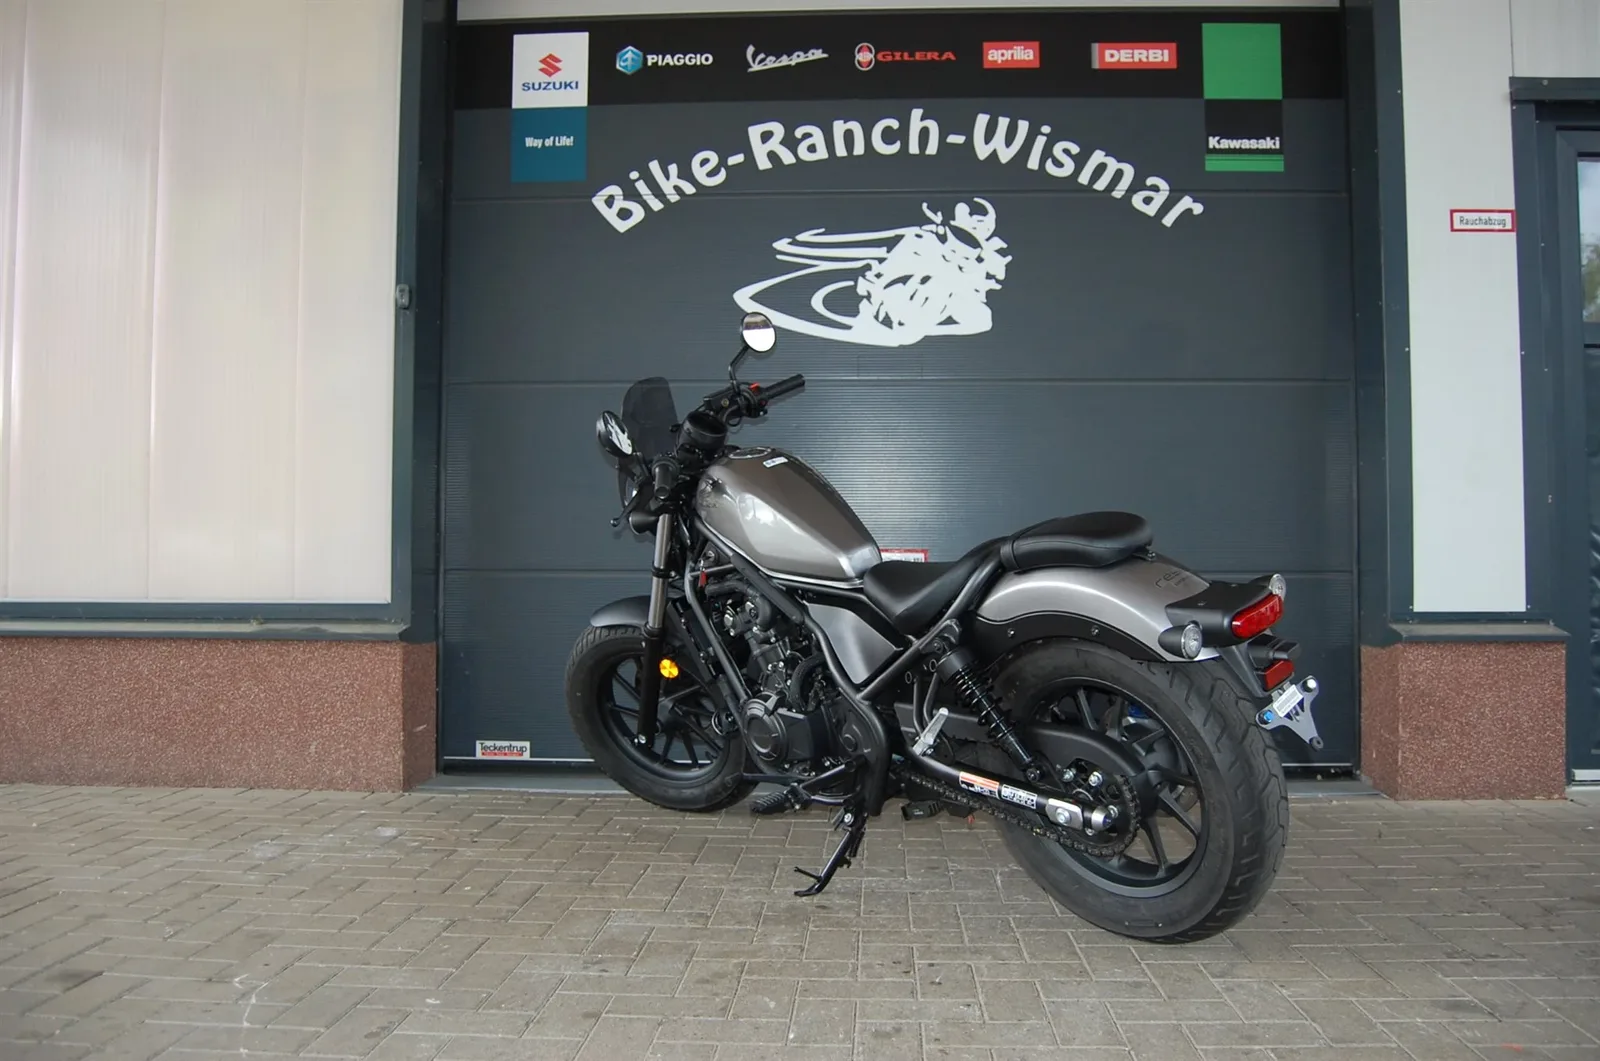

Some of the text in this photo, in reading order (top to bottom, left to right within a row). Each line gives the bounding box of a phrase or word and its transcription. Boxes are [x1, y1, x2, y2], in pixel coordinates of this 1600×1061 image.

[647, 53, 713, 66] PIAGGIO
[746, 44, 828, 70] Vespa
[876, 51, 957, 61] GILERA
[988, 45, 1034, 64] aprilia
[1104, 49, 1170, 62] DERBI
[522, 81, 579, 91] SUZUKI
[525, 135, 574, 148] Way of Life!
[1208, 135, 1281, 149] Kawasaki
[591, 108, 1204, 233] Bike-Ranch-Wismar
[1459, 216, 1506, 228] Rauchabzug
[479, 742, 527, 756] Teckentrup
